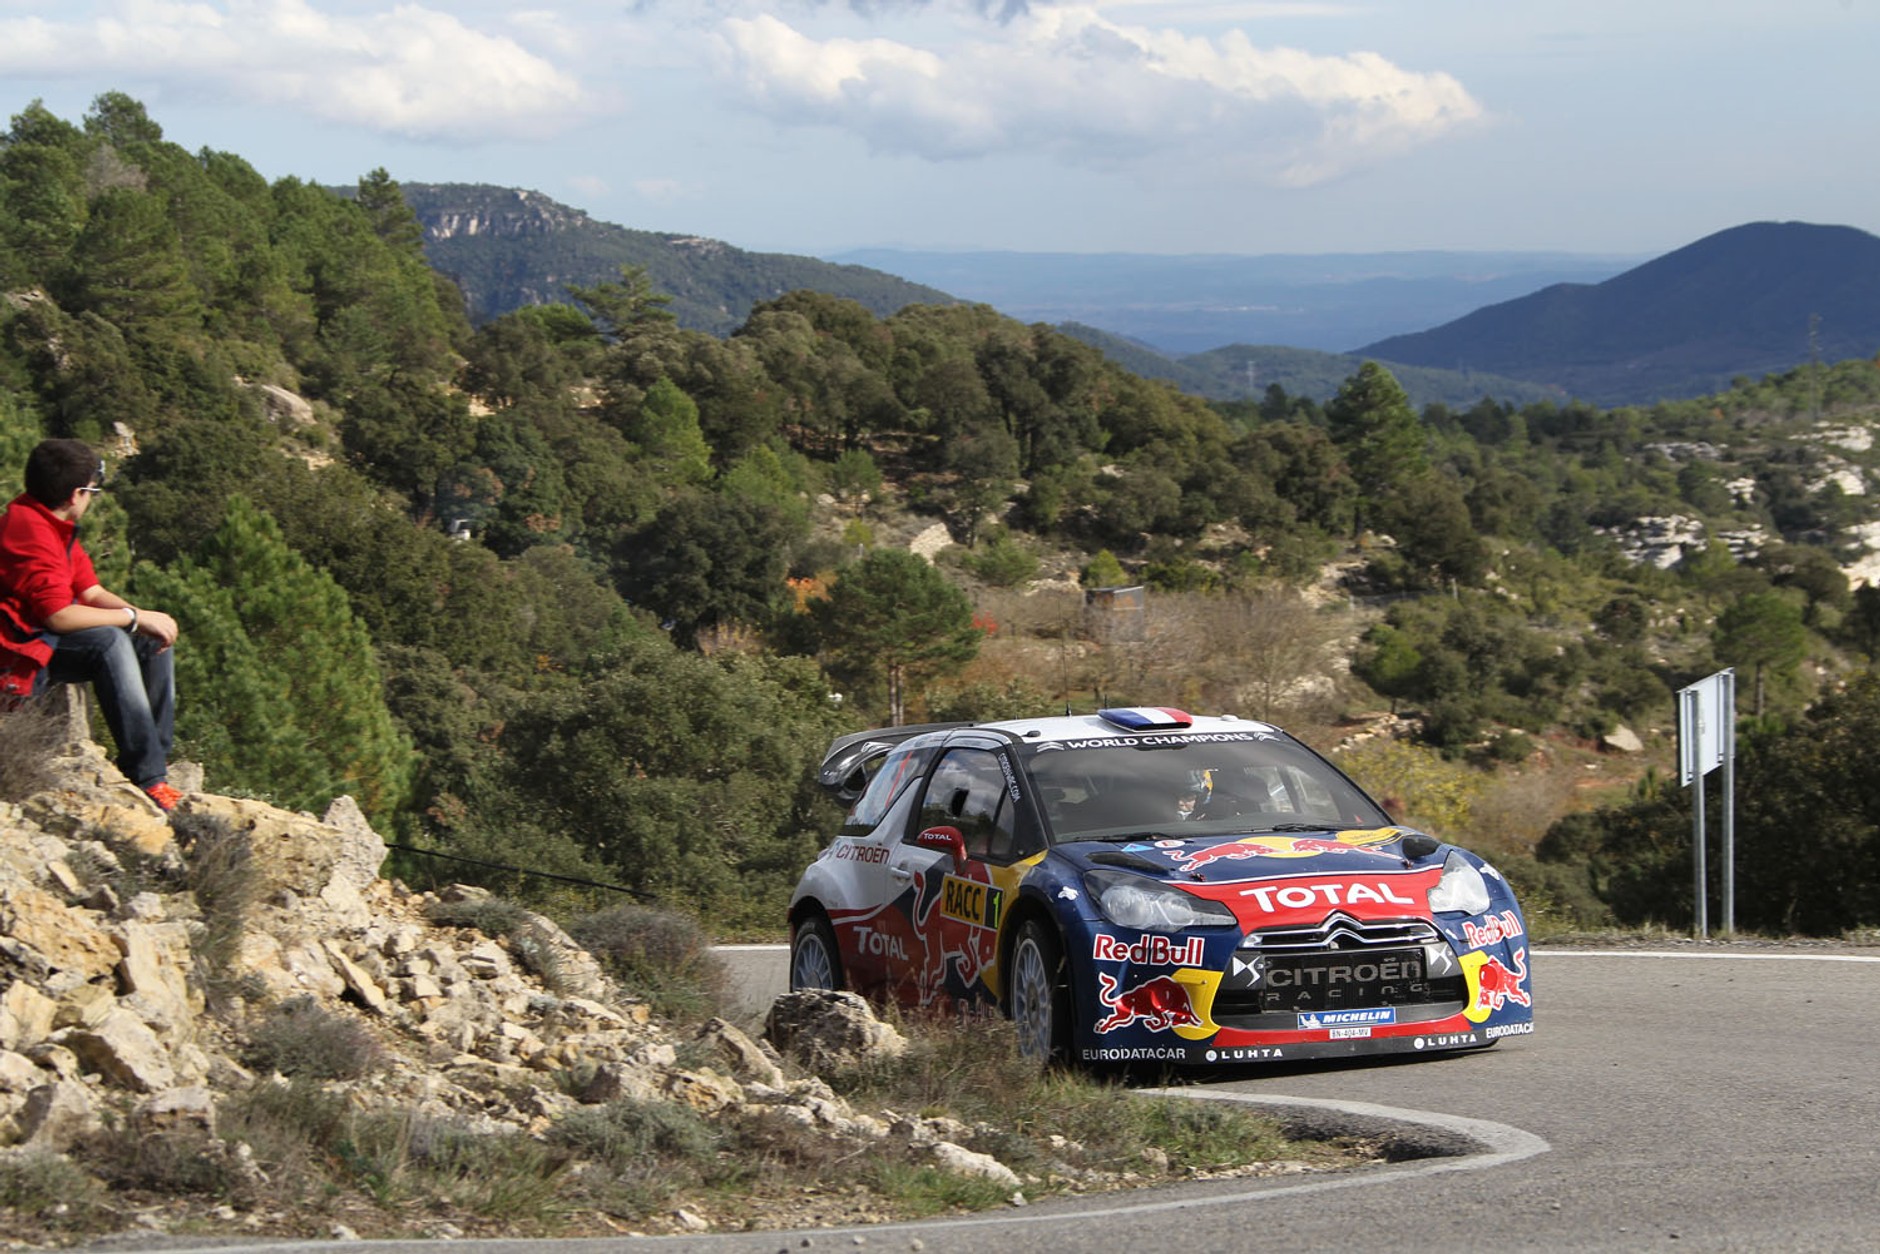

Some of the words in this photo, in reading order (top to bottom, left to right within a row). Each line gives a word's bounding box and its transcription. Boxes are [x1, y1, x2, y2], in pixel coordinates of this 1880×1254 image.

[1067, 738, 1139, 750] WORLD
[1142, 732, 1253, 746] CHAMPIONS
[923, 833, 952, 841] TOTAL
[1240, 883, 1414, 912] TOTAL
[945, 880, 982, 921] RACC
[993, 891, 1001, 929] 1
[852, 925, 910, 961] TOTAL
[1322, 1011, 1391, 1024] MICHELIN
[1428, 1034, 1477, 1047] LUHTA
[1082, 1048, 1186, 1060] EURODATACAR
[1221, 1049, 1283, 1060] LUHTA
